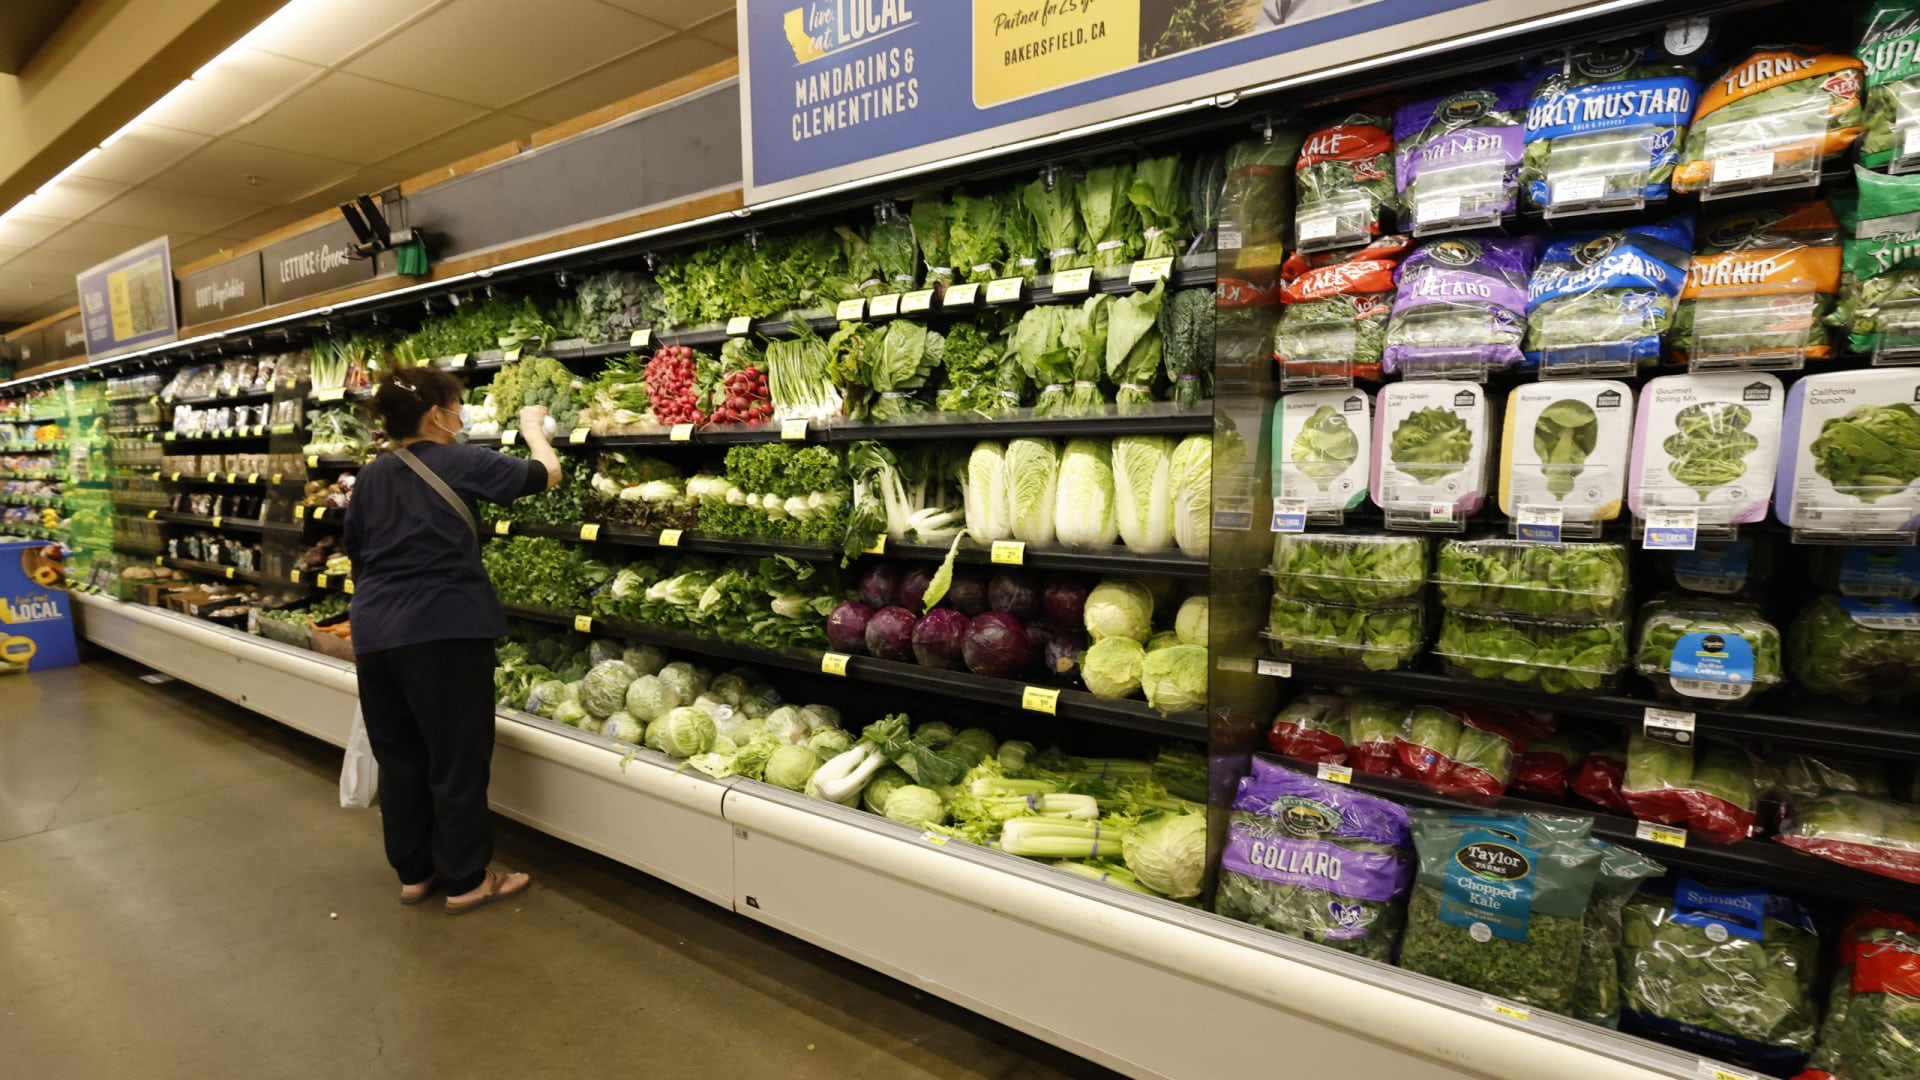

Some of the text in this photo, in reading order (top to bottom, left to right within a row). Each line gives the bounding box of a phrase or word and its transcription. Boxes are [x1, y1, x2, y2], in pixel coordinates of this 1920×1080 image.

[837, 0, 913, 44] LOCAL
[993, 10, 1039, 36] Partner
[1004, 21, 1106, 66] BAKERSFIELD, CA
[795, 47, 915, 109] MANDARINS &
[792, 78, 919, 142] CLEMENTINES
[1526, 86, 1690, 131] URLY MUSTARD
[1302, 133, 1342, 157] ALE
[280, 250, 316, 283] LETTUCE
[1690, 259, 1776, 288] TURNIP
[1302, 267, 1345, 294] KALE
[1656, 387, 1692, 395] Gourmet
[1810, 388, 1857, 396] California
[10, 601, 62, 621] LOCAL
[1250, 841, 1342, 881] COLLARD
[1468, 846, 1521, 868] Taylor
[1474, 862, 1507, 874] FARMS
[1457, 876, 1520, 900] Chopped
[1470, 892, 1502, 910] Kale
[1687, 890, 1753, 911] Spinach
